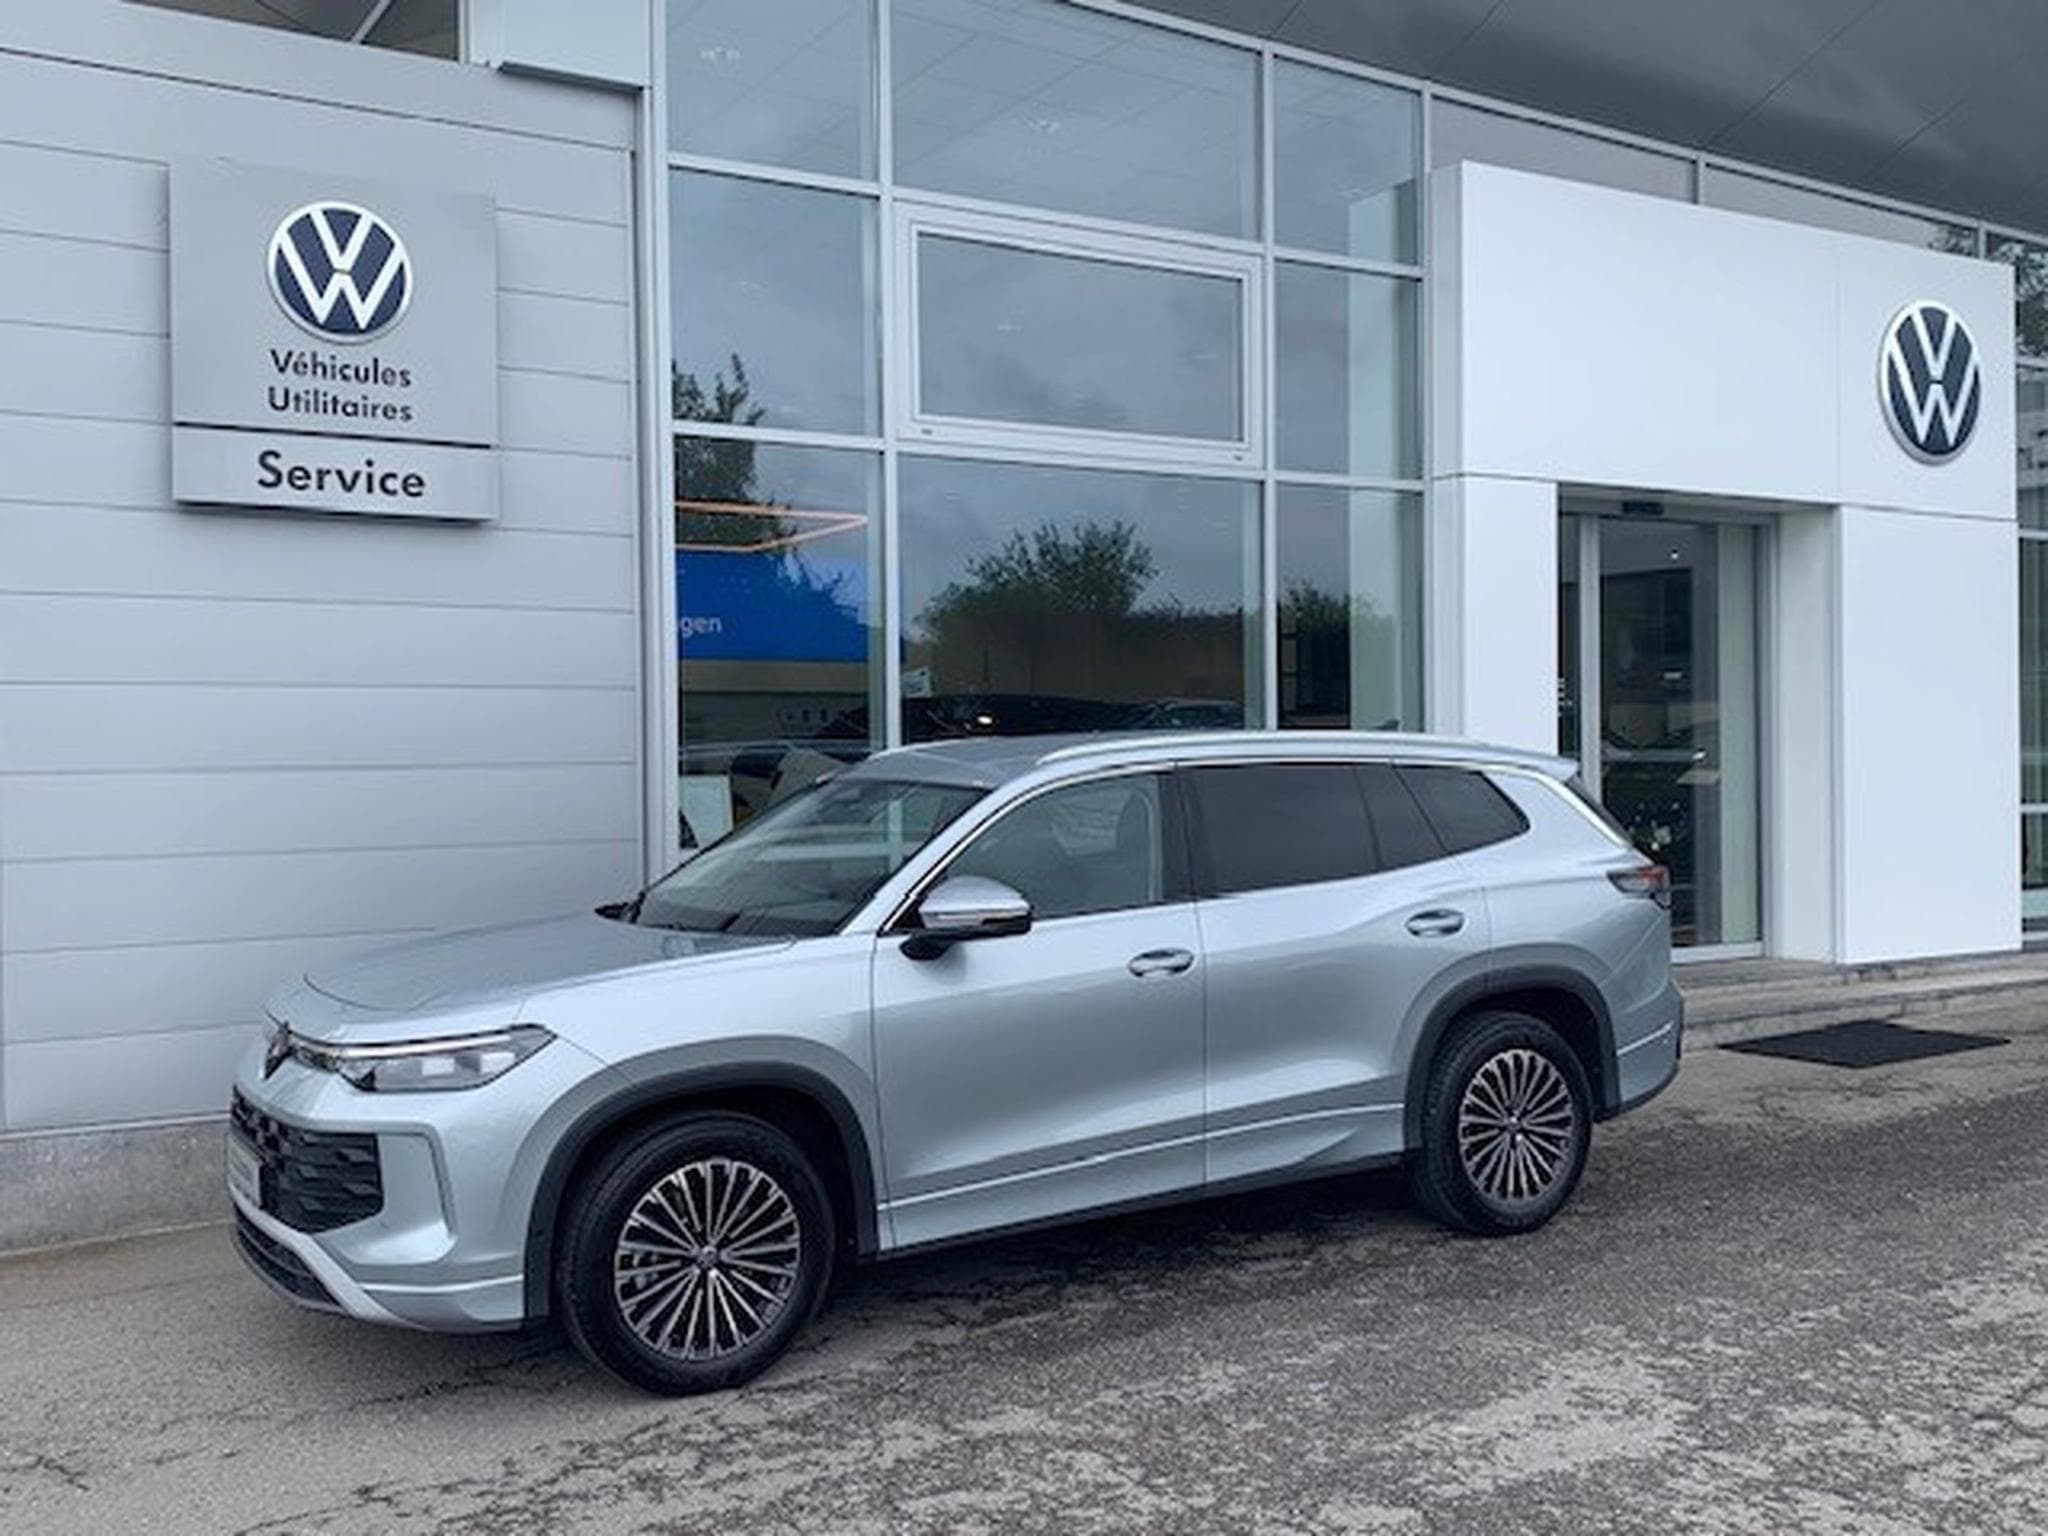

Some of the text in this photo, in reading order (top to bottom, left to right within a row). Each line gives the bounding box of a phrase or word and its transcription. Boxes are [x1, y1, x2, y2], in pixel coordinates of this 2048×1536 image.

[269, 349, 412, 388] Véhicules
[267, 386, 413, 422] Utilitaires
[257, 450, 426, 498] Service
